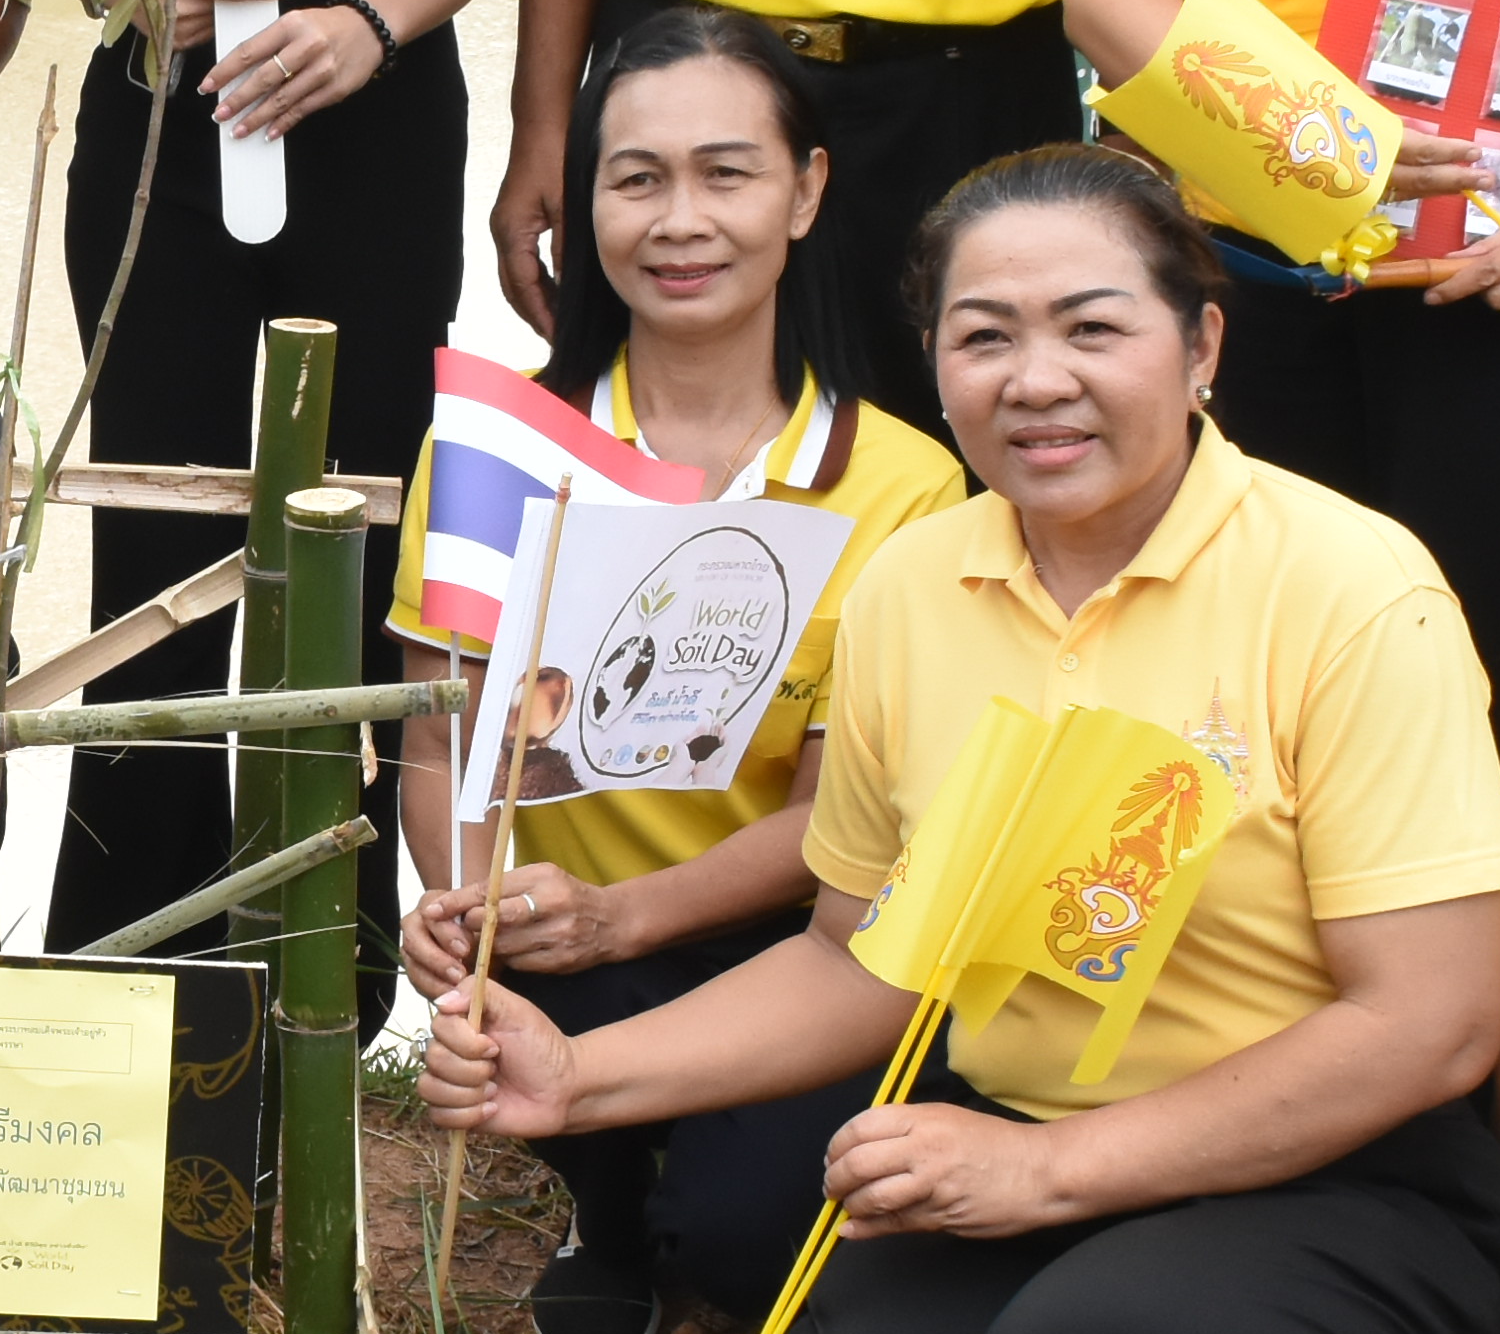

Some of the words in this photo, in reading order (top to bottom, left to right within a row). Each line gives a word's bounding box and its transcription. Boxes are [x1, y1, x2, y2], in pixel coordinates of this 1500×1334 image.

[696, 599, 769, 631] World
[668, 634, 712, 665] Soil
[711, 634, 764, 676] Day
